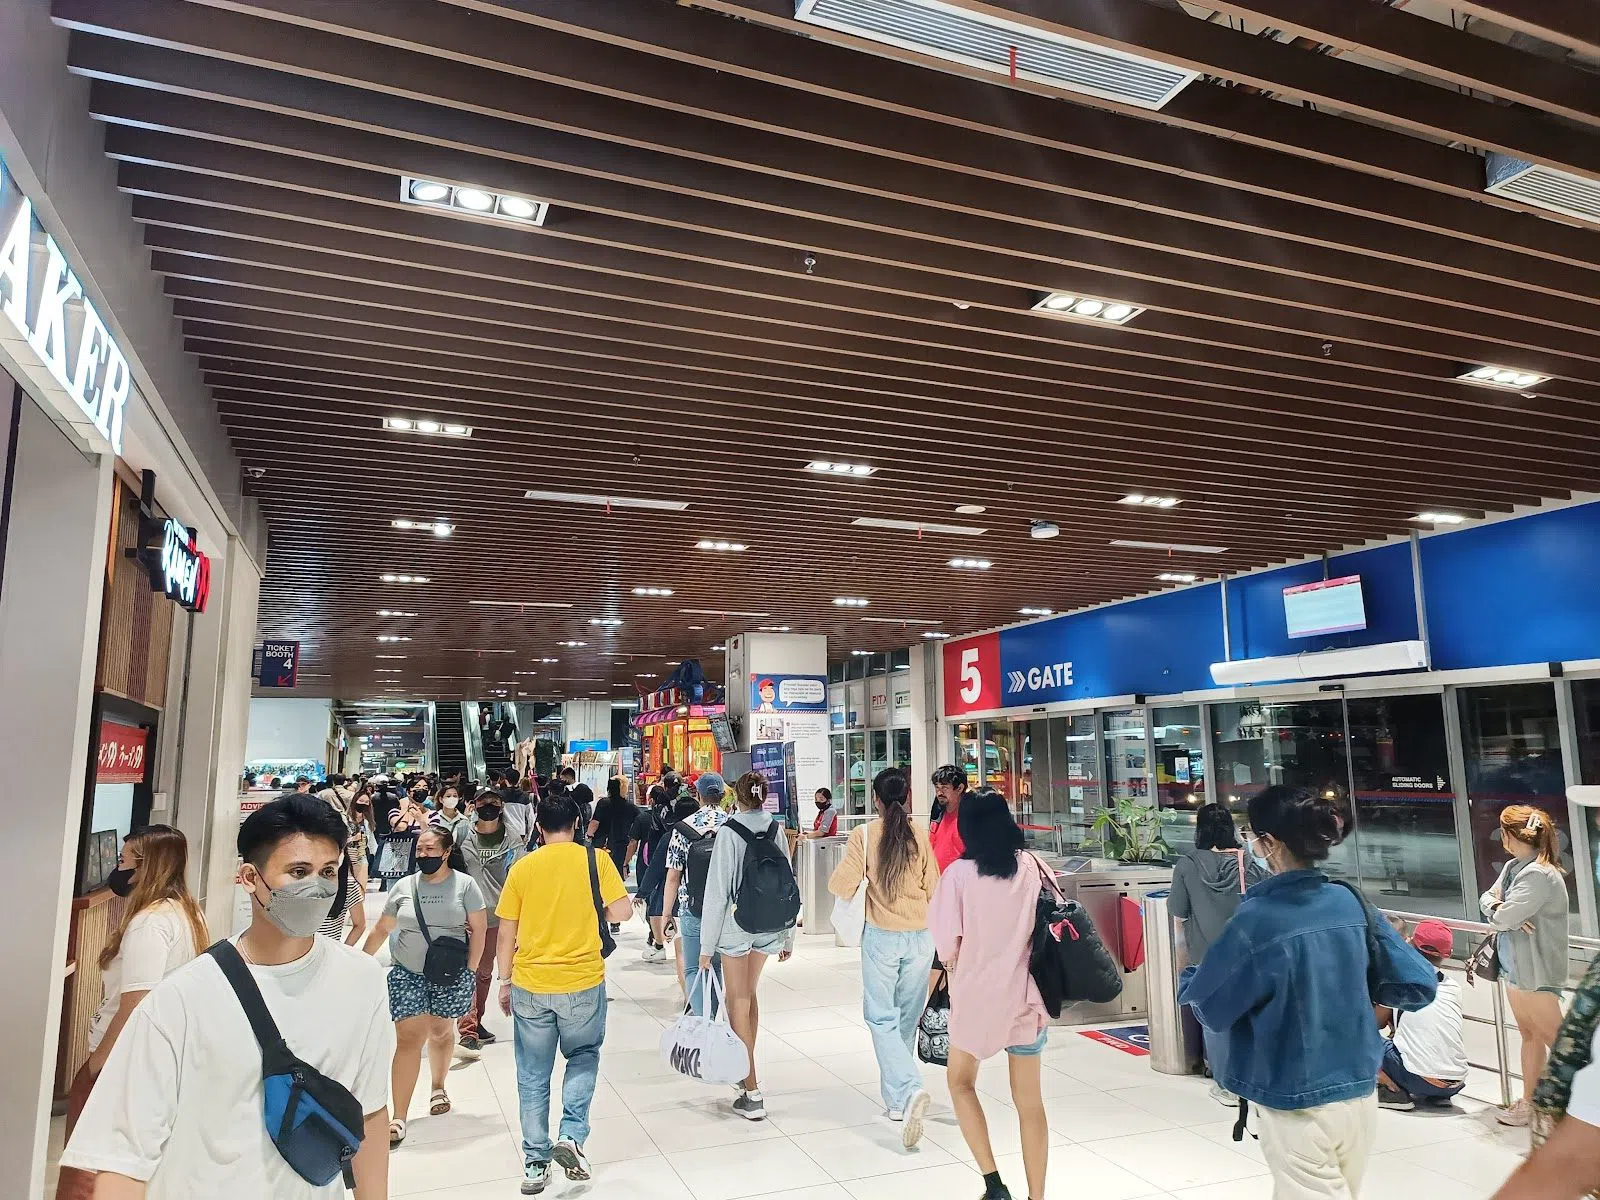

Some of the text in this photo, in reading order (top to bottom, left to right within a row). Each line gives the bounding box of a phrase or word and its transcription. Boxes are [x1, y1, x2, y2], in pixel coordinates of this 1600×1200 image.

[0, 160, 130, 456] AKER
[283, 658, 293, 670] 4
[960, 648, 1073, 704] 5 GATE
